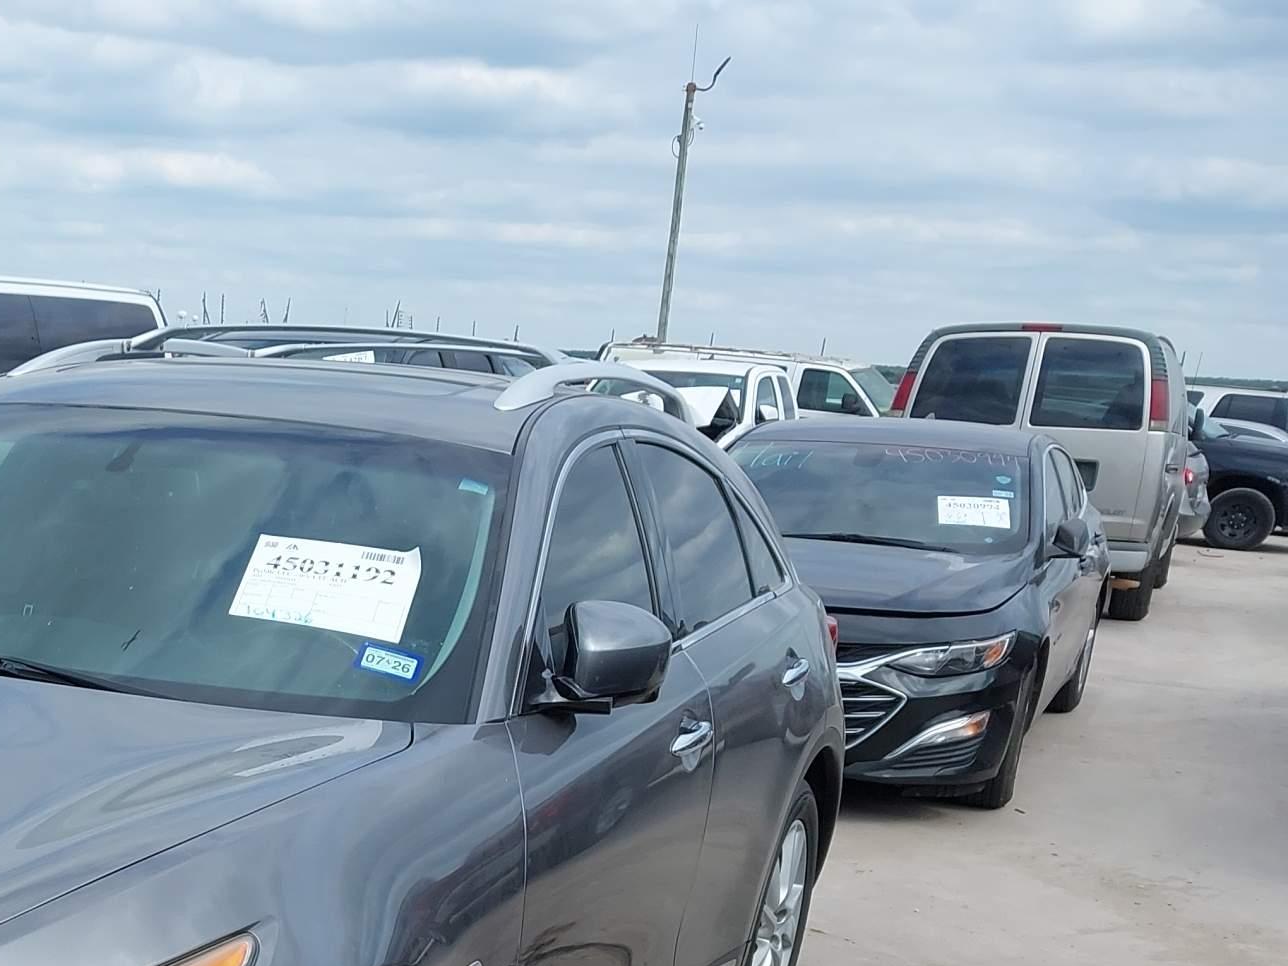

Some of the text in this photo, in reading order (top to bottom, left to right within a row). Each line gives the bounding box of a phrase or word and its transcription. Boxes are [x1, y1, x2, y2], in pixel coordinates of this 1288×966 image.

[266, 555, 396, 586] 45031192
[365, 653, 412, 674] 07 26
